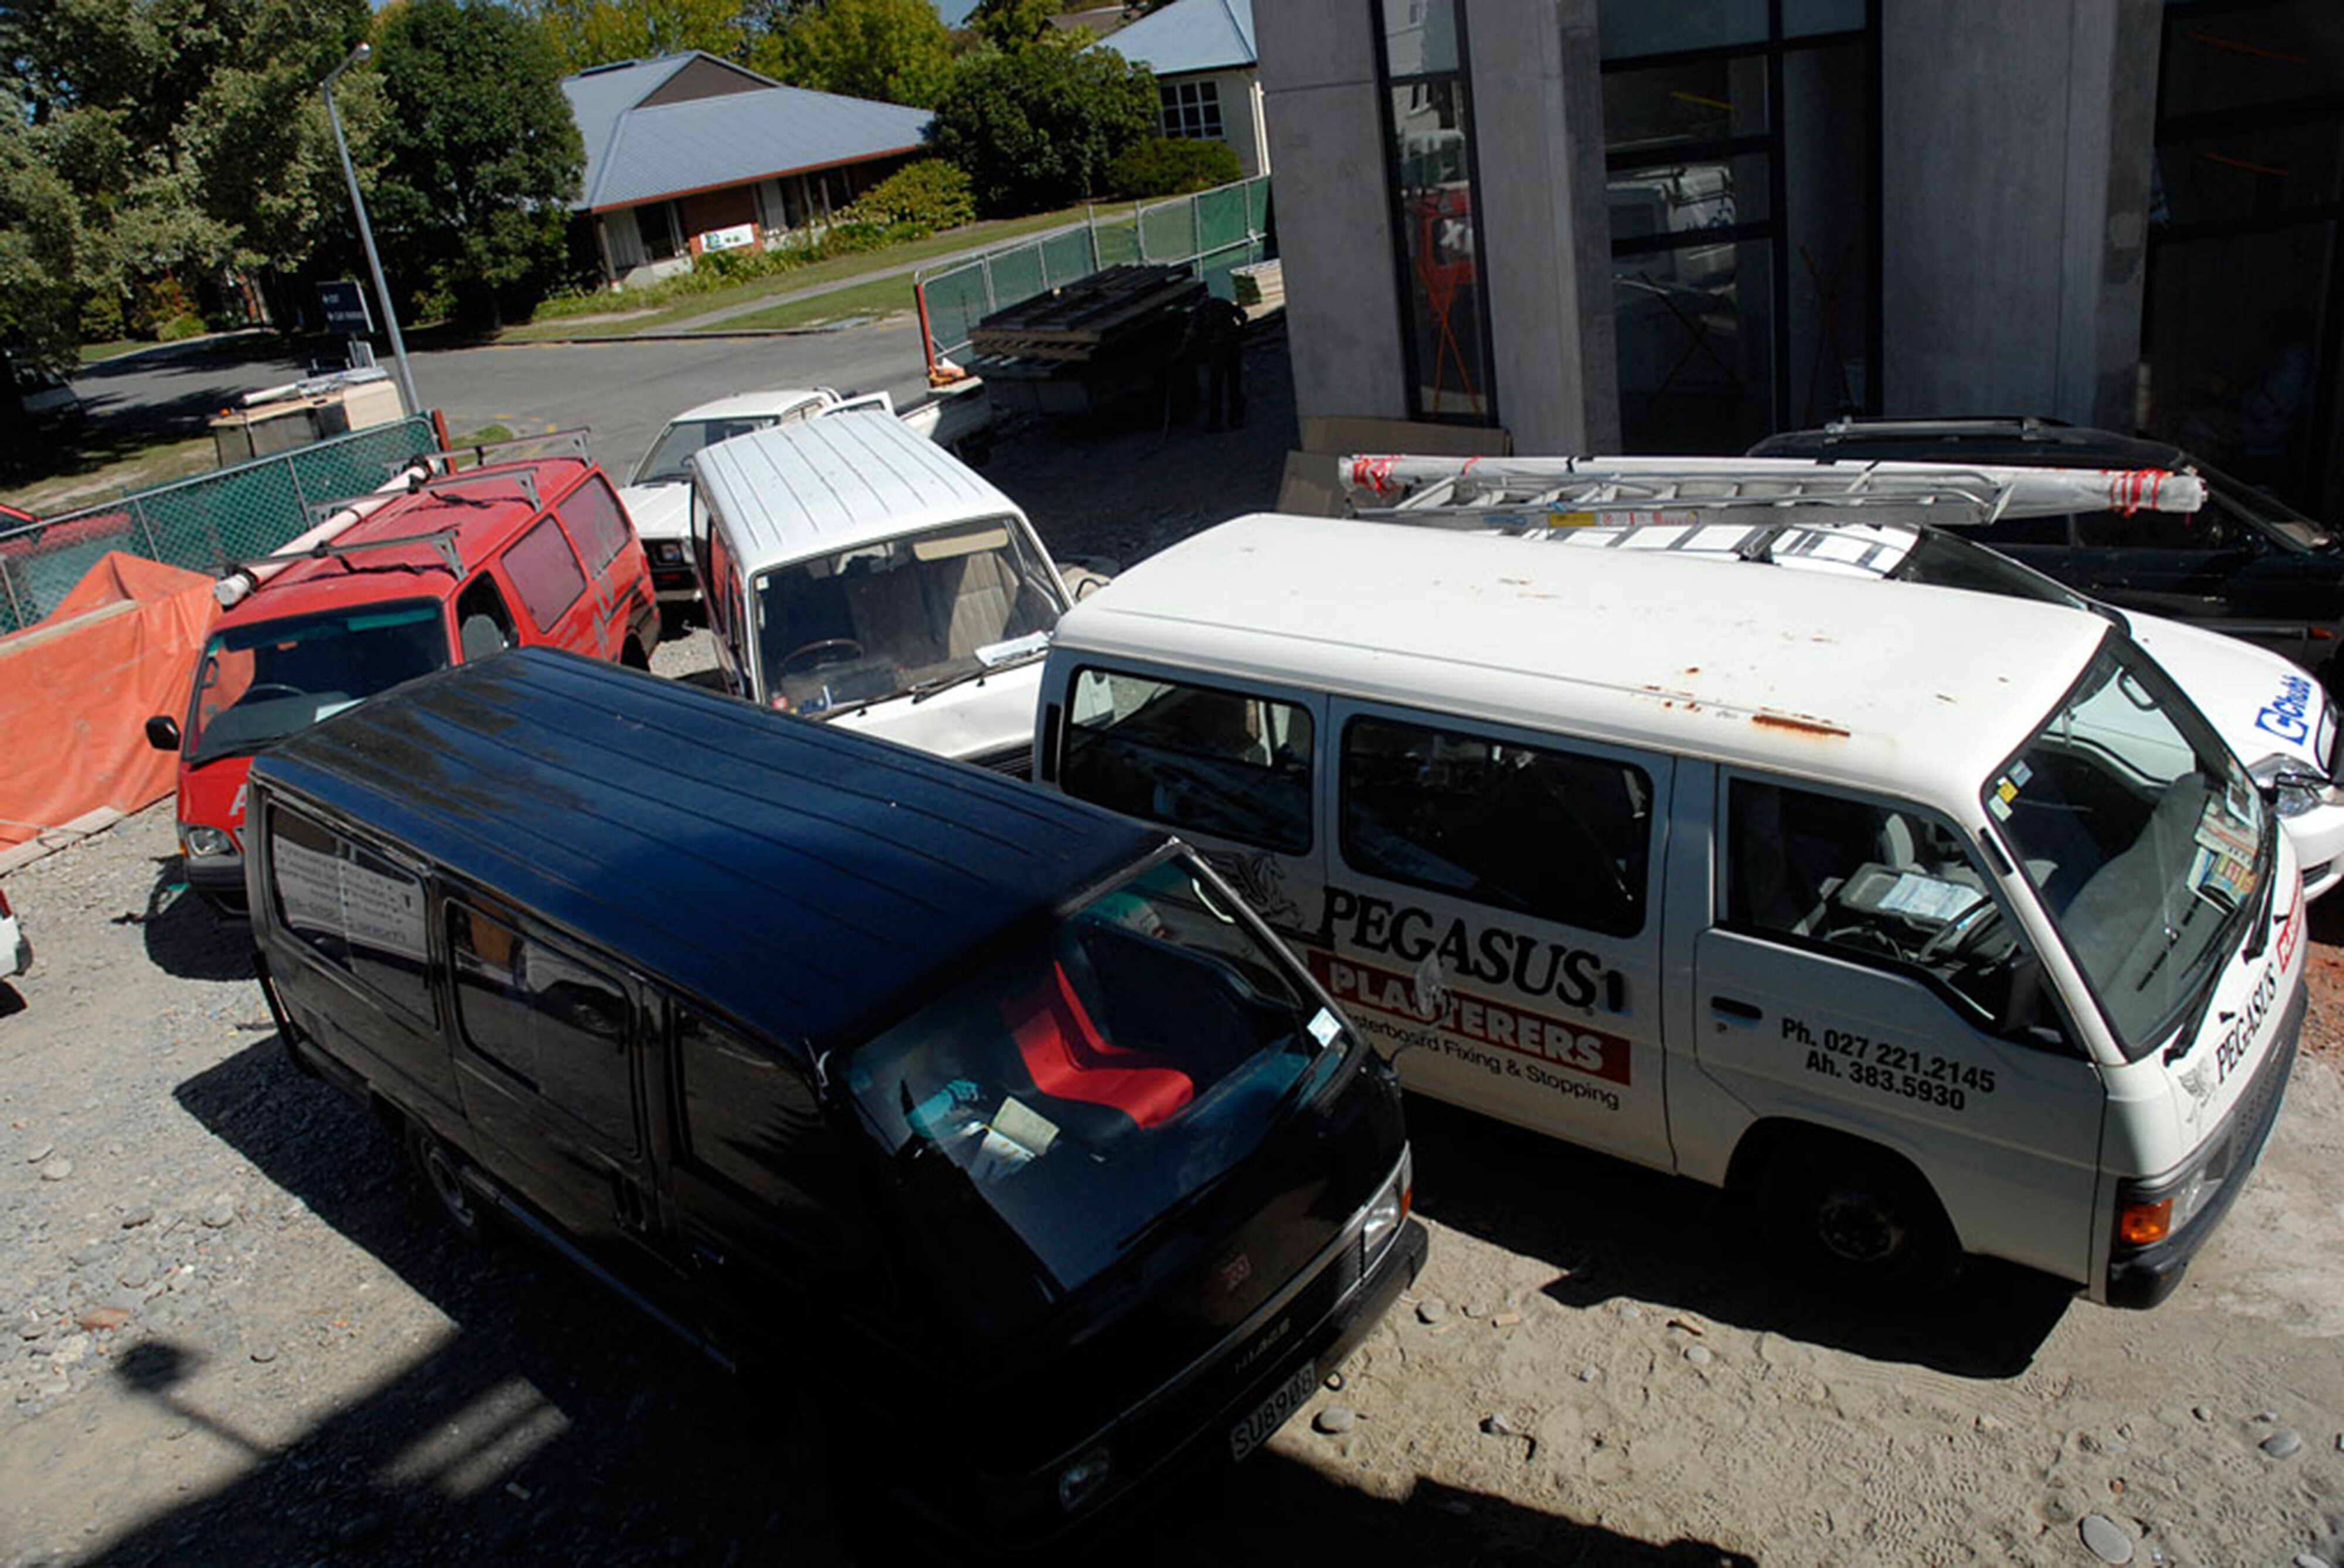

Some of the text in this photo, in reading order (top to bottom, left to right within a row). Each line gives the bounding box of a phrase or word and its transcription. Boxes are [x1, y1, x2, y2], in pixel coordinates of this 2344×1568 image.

[1318, 886, 1604, 1008] PEGASUS
[1781, 1018, 1996, 1093] Ph. 027 221.2145
[2215, 961, 2277, 1084] PEGASUS
[1444, 1039, 1502, 1074] Fixing
[1506, 1058, 1522, 1078] &
[1525, 1062, 1621, 1111] Stopping
[1806, 1050, 1965, 1111] Ah. 383.5930
